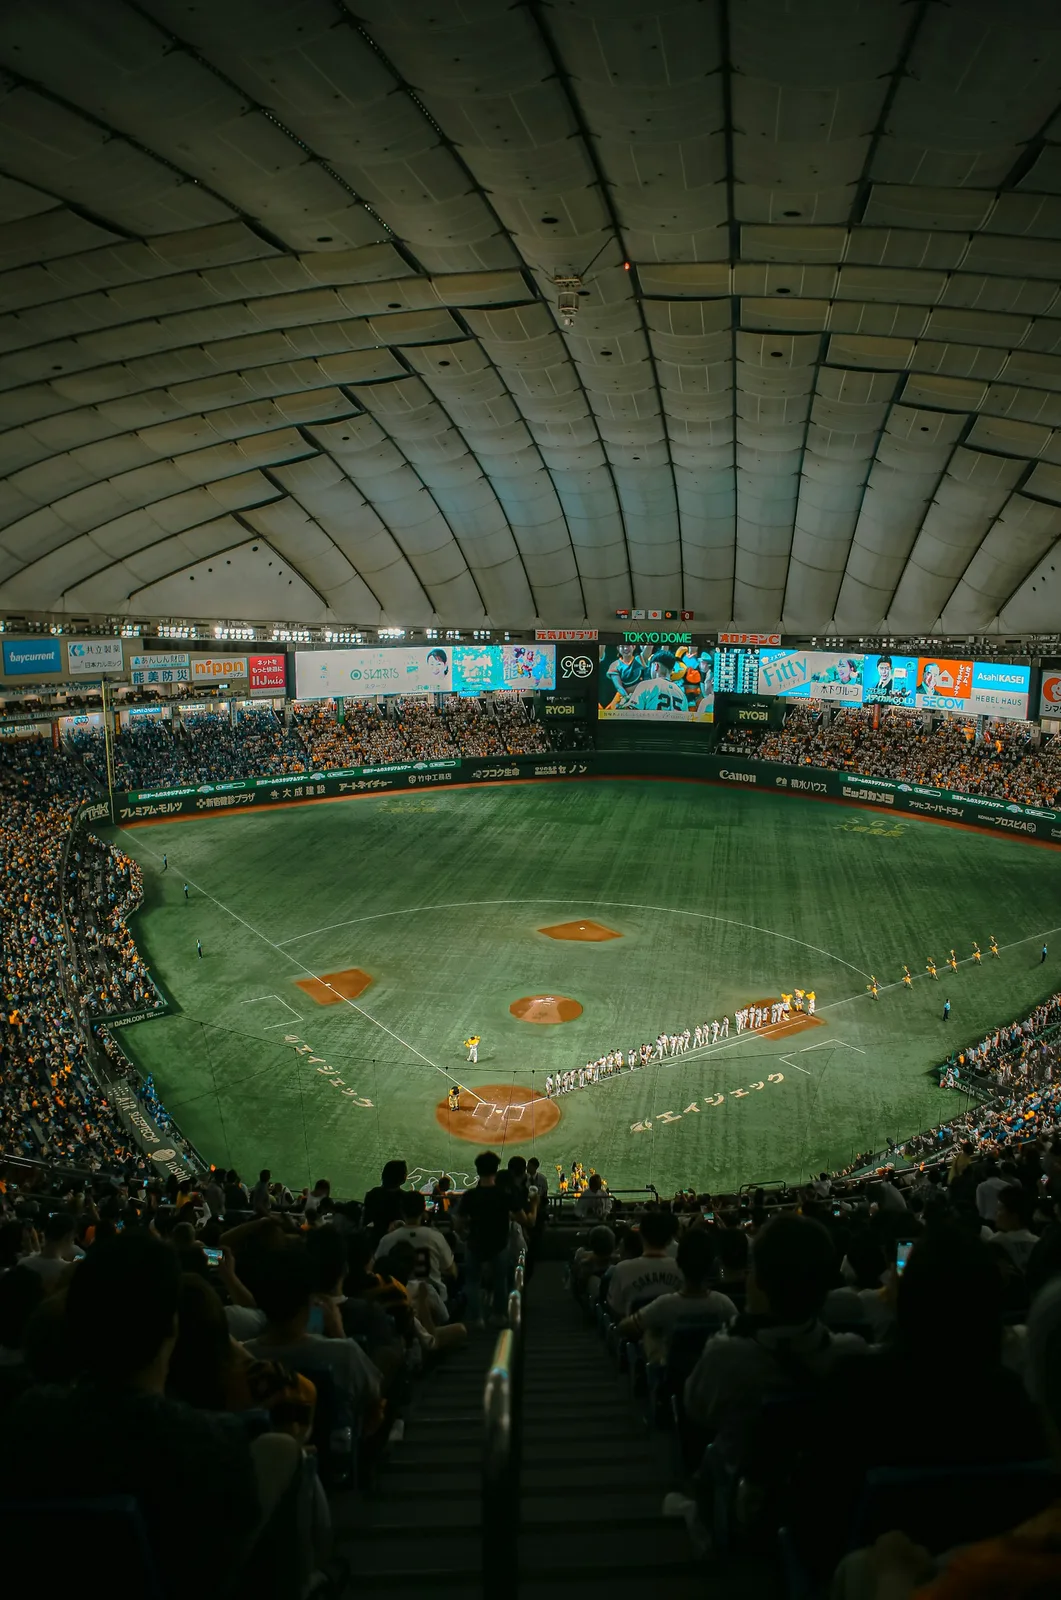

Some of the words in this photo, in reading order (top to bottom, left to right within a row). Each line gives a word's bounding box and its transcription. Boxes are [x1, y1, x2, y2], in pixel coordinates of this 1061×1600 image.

[537, 630, 597, 640] 元気ハツラツ!
[623, 631, 660, 643] TOKYO
[661, 632, 692, 643] DOME
[720, 633, 779, 644] オロナミンC
[86, 645, 120, 655] 共立製薬
[10, 652, 54, 663] baycurrent
[141, 654, 186, 664] あんしん財団
[195, 660, 244, 676] nippn
[252, 666, 283, 674] もっと快適に
[762, 658, 807, 687] Fitty
[133, 670, 188, 684] 能美防災
[252, 675, 284, 686] IIJmio
[820, 685, 859, 697] 木下グループ
[922, 696, 964, 711] SECOM
[976, 695, 999, 704] HEBEL
[1001, 697, 1022, 706] HAUS
[545, 705, 575, 715] RYOBI
[739, 710, 768, 721] RYOBI
[482, 767, 520, 778] フコク生命
[558, 765, 587, 774] セノン
[418, 773, 452, 782] 竹中工務店
[719, 769, 757, 783] Canon
[282, 784, 326, 799] 大成建設
[339, 780, 393, 791] アートネイチャー
[791, 779, 827, 793] 積水ハウス
[842, 786, 895, 804] ビックカメラ
[86, 802, 109, 819] THK
[120, 802, 183, 818] プレミアム・モルツ
[995, 816, 1027, 831] プロスピA
[114, 1014, 145, 1027] DAZN.COM
[656, 1072, 784, 1124] エイジェック
